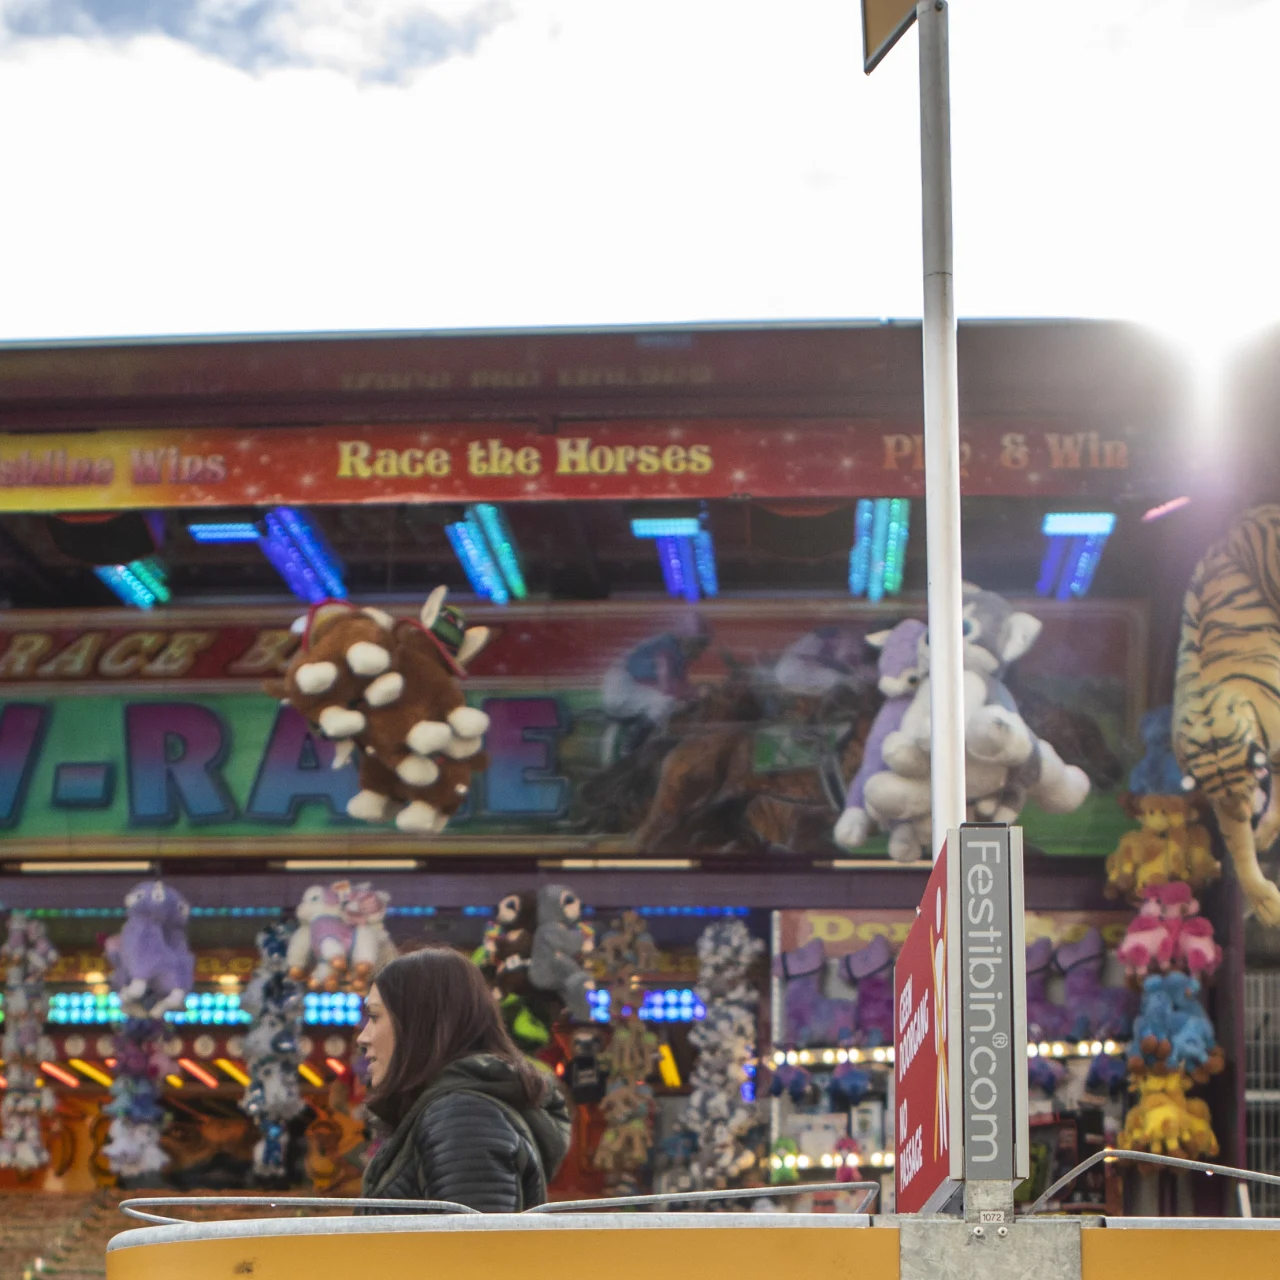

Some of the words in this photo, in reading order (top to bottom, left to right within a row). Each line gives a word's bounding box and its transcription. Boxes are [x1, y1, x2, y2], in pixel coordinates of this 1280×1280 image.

[130, 446, 228, 485] Wins
[337, 439, 451, 478] Race
[467, 438, 540, 476] the
[556, 436, 713, 475] Horses
[1001, 432, 1029, 470] &
[1044, 429, 1129, 469] Win
[899, 974, 912, 1033] GEEN
[899, 988, 929, 1082] DOORGANG
[899, 1098, 908, 1146] NO
[900, 1124, 923, 1193] PASSAGE
[982, 1213, 1002, 1221] 1072
